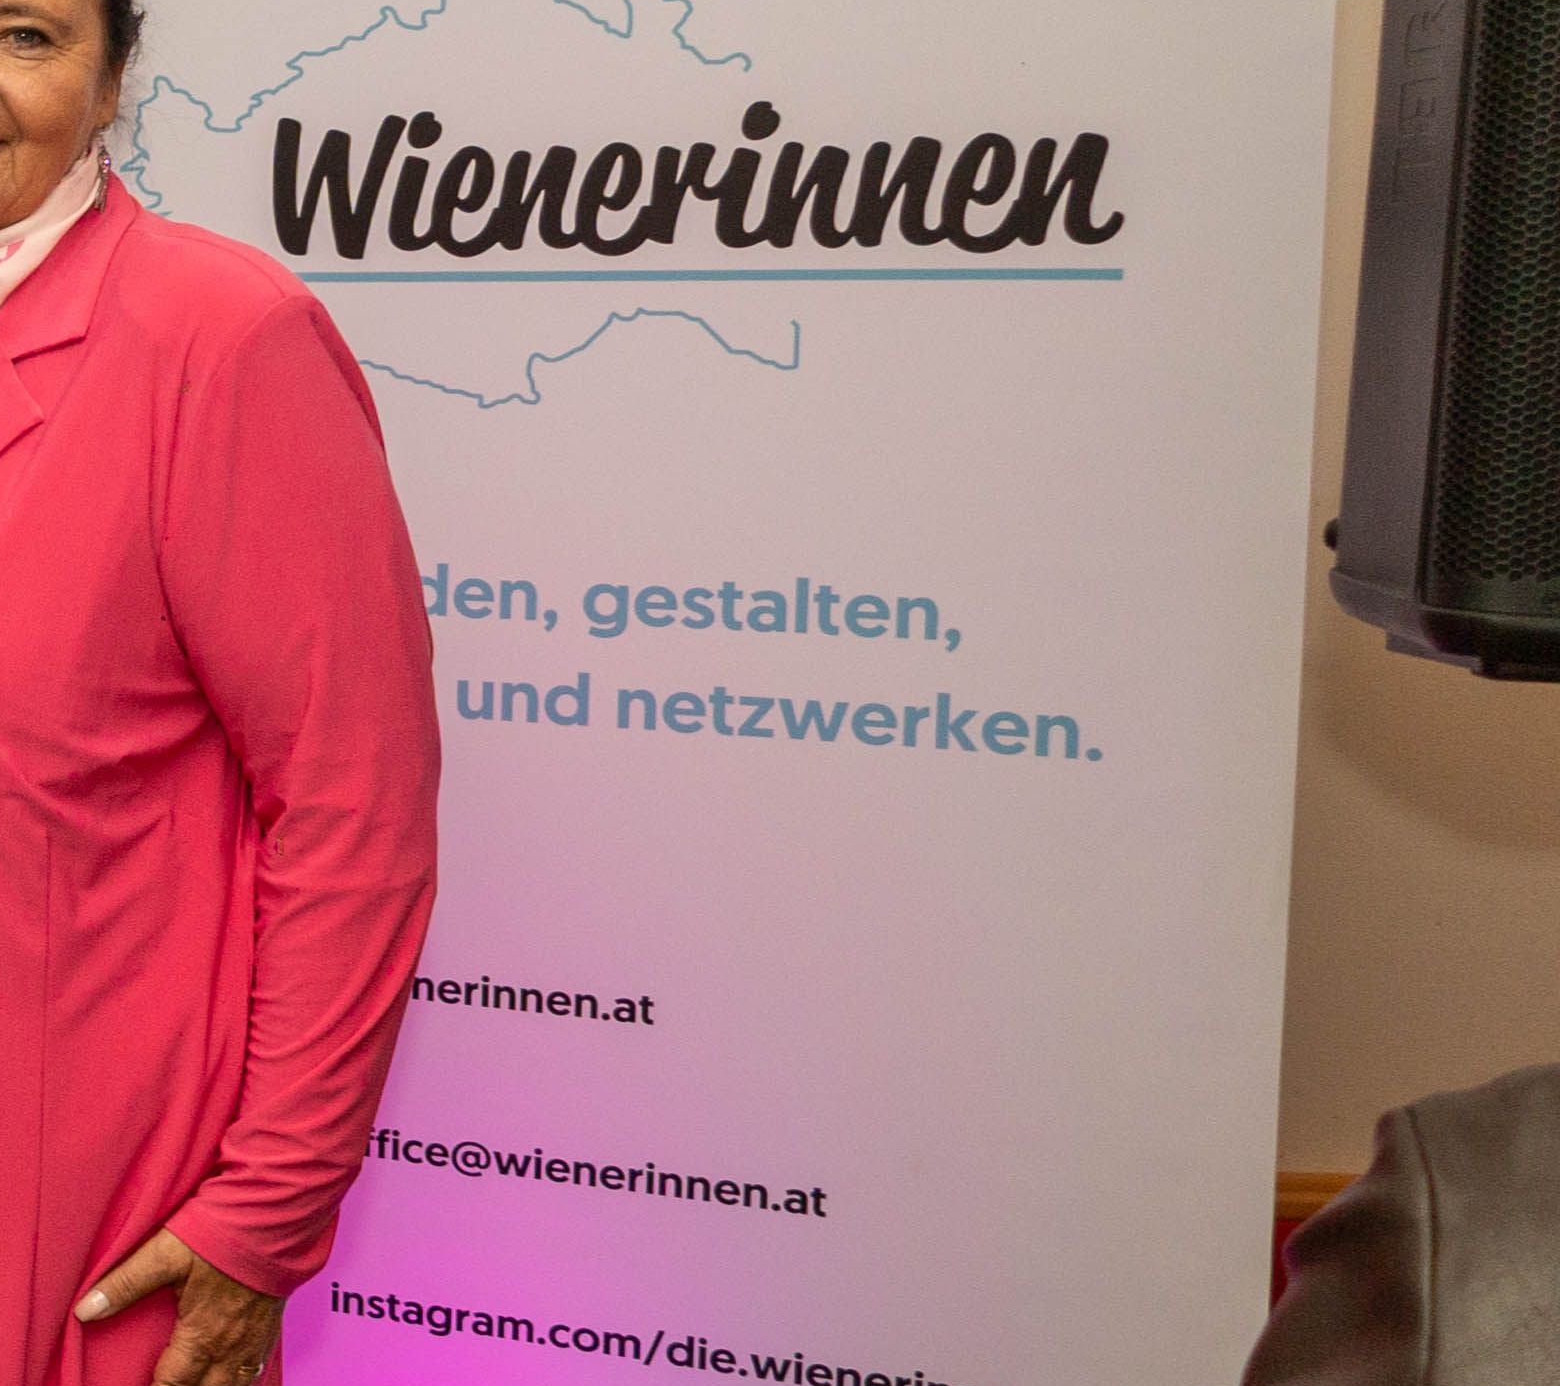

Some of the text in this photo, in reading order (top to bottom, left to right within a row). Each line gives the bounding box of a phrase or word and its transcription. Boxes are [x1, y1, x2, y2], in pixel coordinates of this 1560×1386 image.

[273, 101, 1124, 260] Wienerinnen
[582, 575, 963, 654] gestalten,
[456, 671, 1104, 762] und netzwerken.
[411, 976, 653, 1025] nerinnen.at
